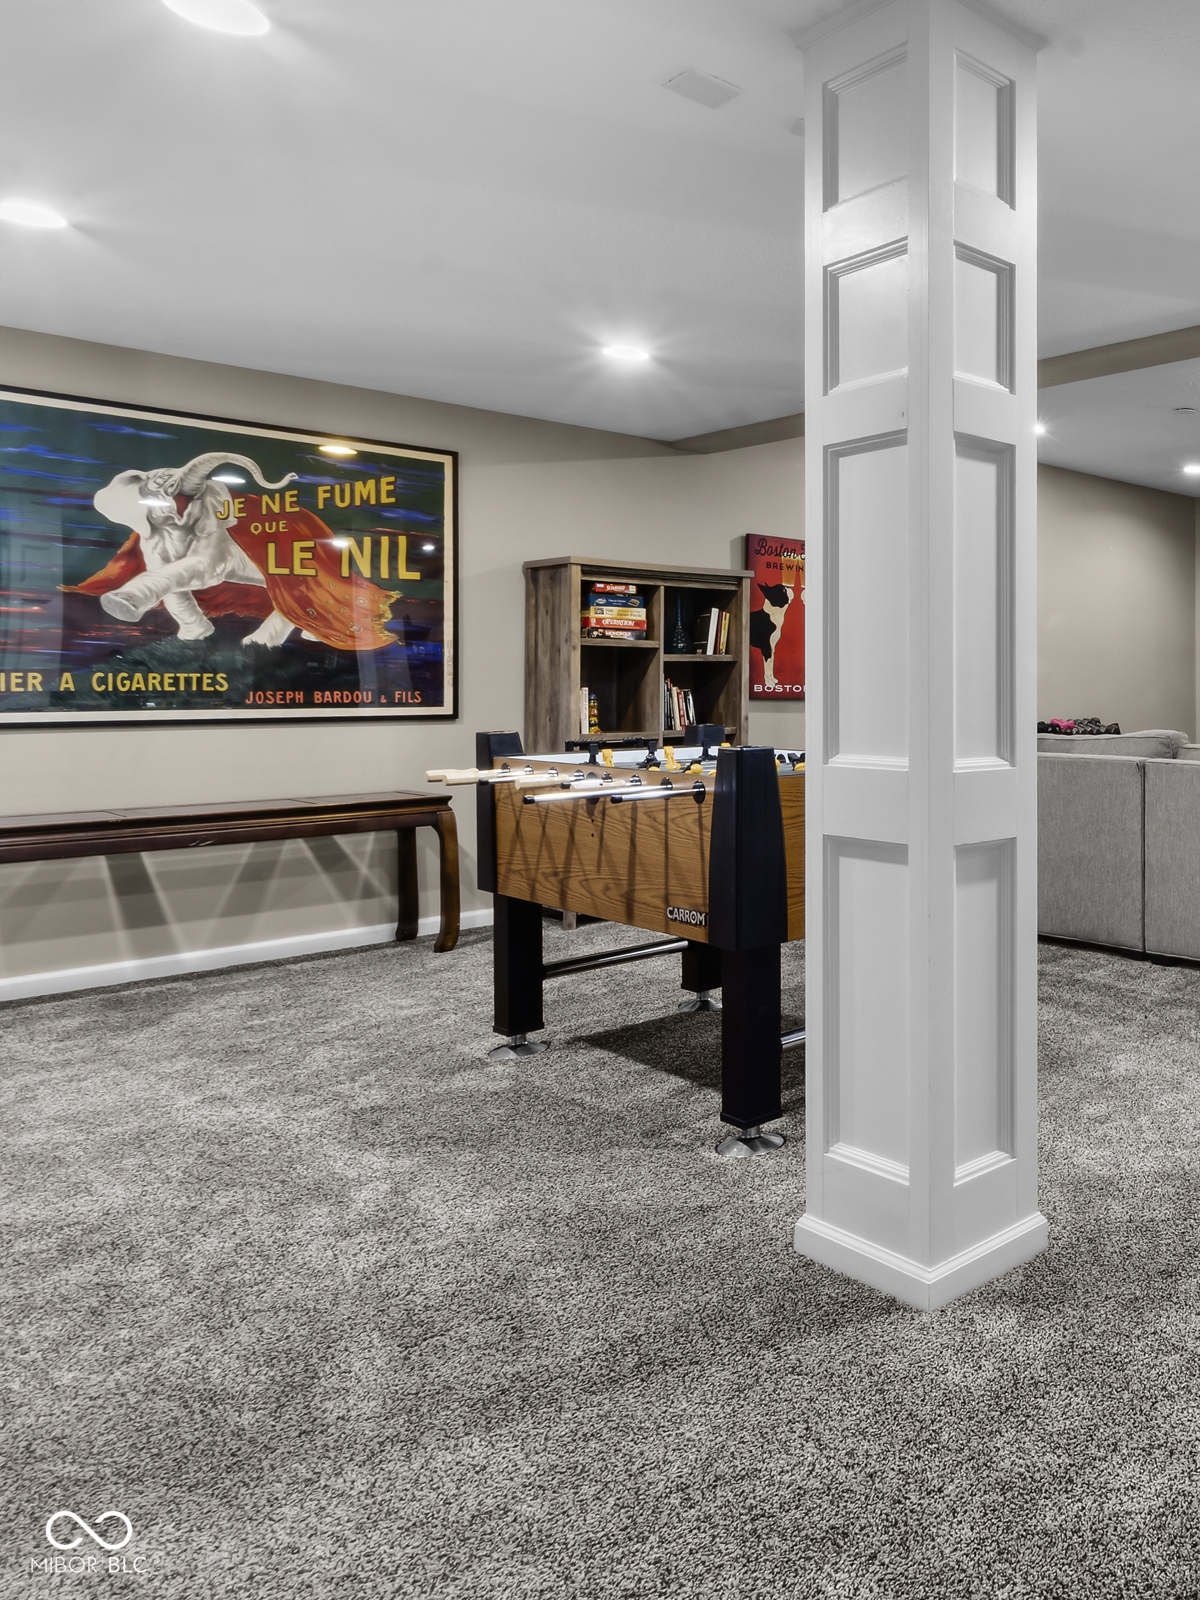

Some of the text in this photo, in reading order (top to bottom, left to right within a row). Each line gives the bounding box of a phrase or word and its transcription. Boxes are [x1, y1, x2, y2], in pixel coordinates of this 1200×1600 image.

[216, 476, 396, 519] JE NE FUME
[250, 520, 289, 535] QUE
[266, 535, 421, 580] LE NIL
[755, 538, 798, 560] Boston
[766, 561, 804, 572] BREWIN
[59, 672, 75, 692] A
[91, 672, 229, 692] CIGARETTES
[245, 690, 422, 705] JOSEPH BARDOU & FILS
[666, 906, 706, 925] CARROM
